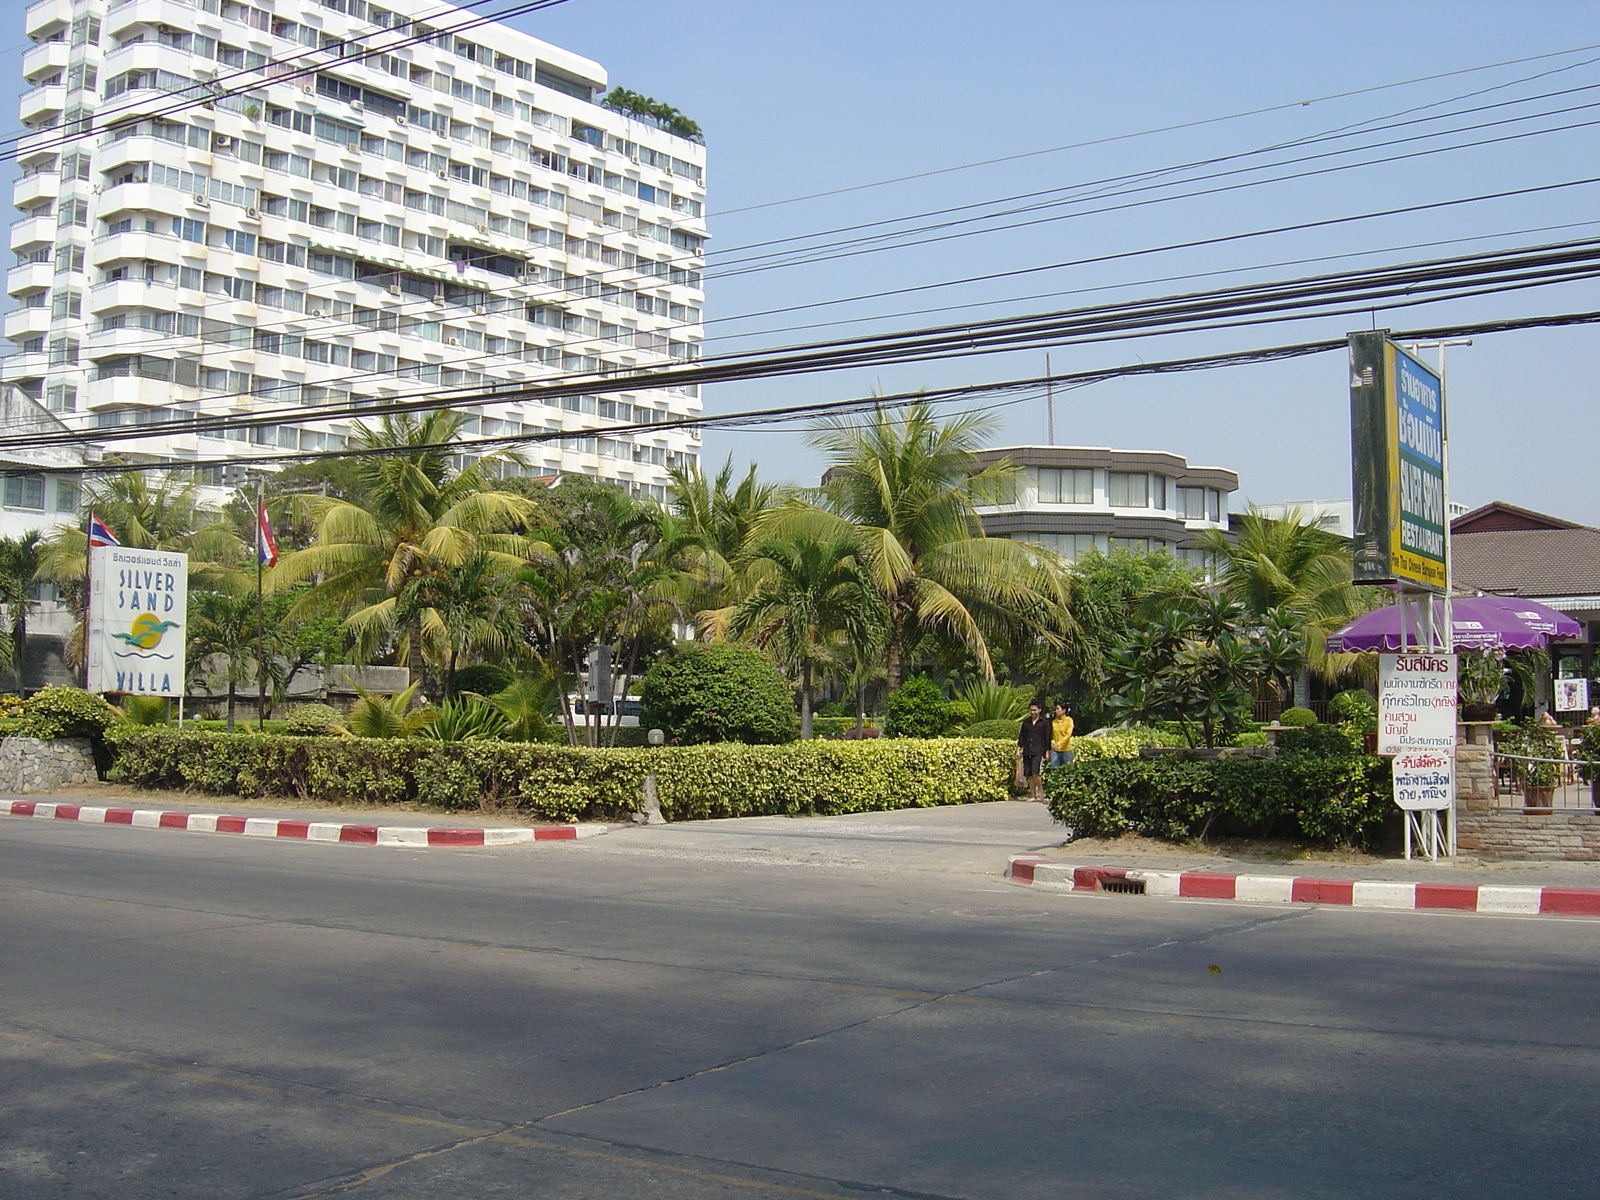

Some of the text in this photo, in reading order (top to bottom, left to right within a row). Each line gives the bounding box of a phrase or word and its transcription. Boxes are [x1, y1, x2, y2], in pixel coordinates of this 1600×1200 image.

[1401, 359, 1437, 413] ร้านอาหาร
[1400, 458, 1443, 526] SILVER SPOON
[1401, 519, 1443, 557] RESTAURANT
[119, 568, 174, 592] SILVER
[118, 590, 174, 612] SAND
[1396, 655, 1449, 672] รับสมัคร
[117, 671, 171, 692] VILLA
[1384, 712, 1417, 723] คนสวน
[1385, 722, 1409, 735] บัญชี
[1385, 746, 1402, 754] 038
[1401, 754, 1444, 769] รับสมัคร
